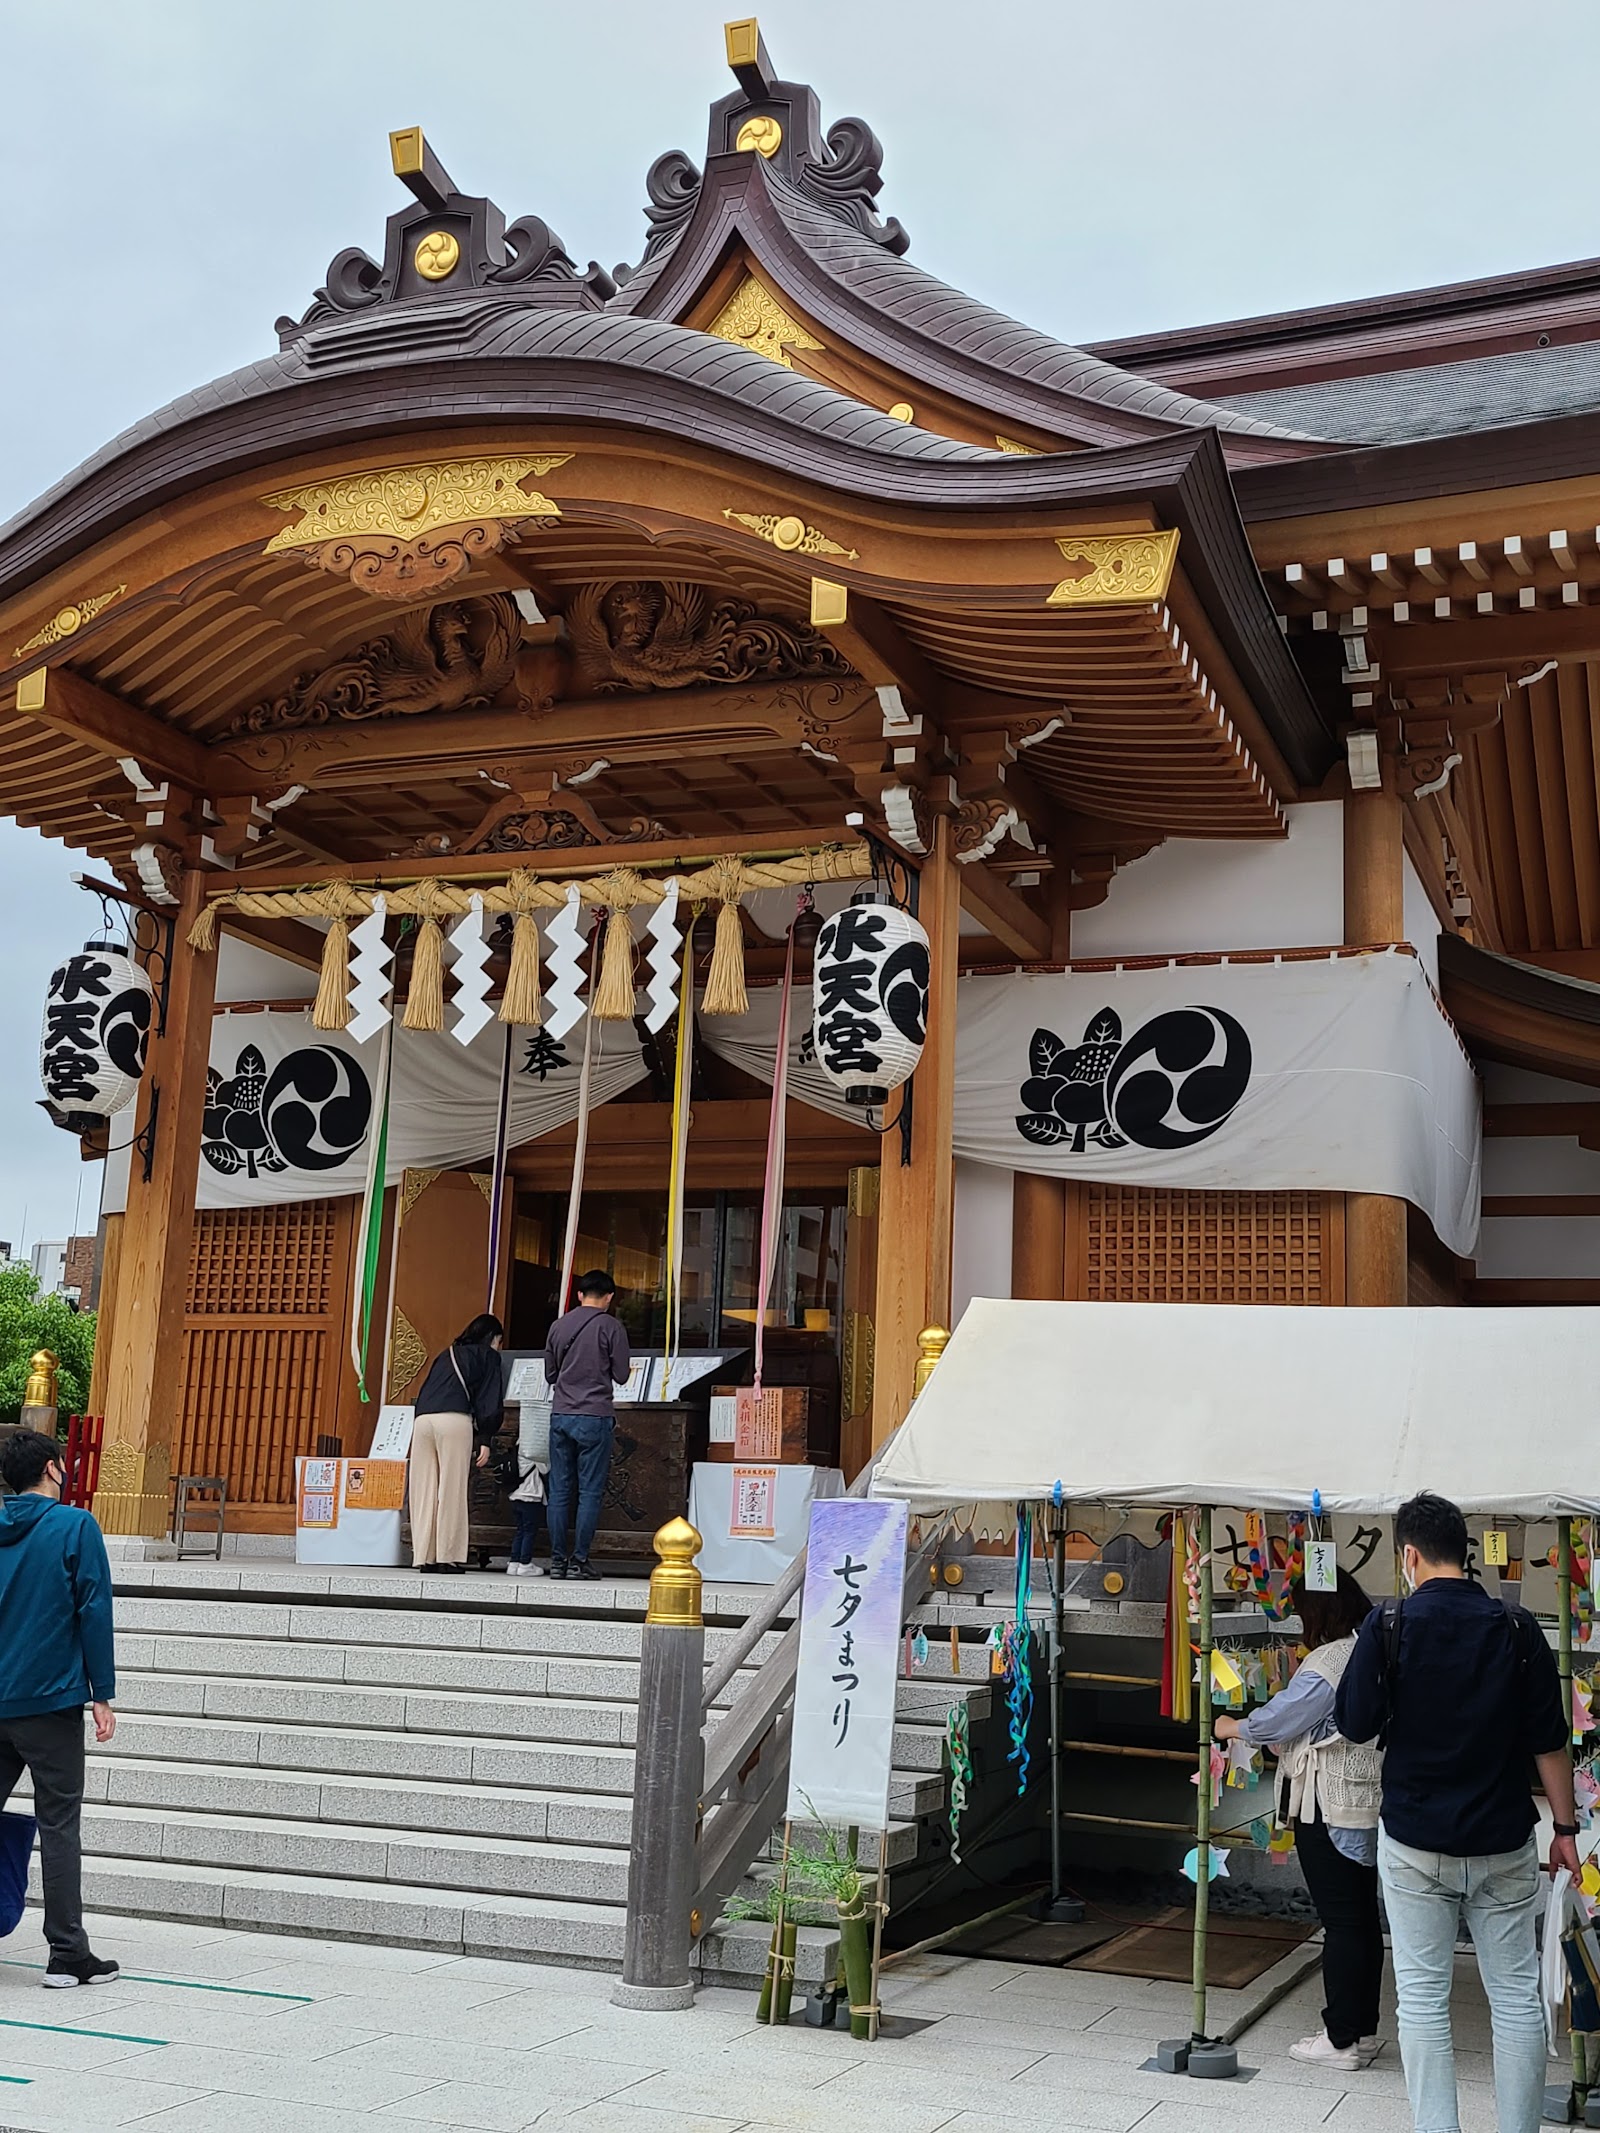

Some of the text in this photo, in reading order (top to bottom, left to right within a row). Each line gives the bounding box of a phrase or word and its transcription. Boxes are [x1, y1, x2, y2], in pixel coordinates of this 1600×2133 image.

[43, 955, 112, 1102] 水天宮
[817, 908, 887, 1074] 水天宮
[518, 1024, 572, 1083] 奉
[1313, 1546, 1326, 1588] 七夕まつり
[1489, 1532, 1500, 1564] 七夕まつり
[830, 1553, 868, 1750] 七夕まつり
